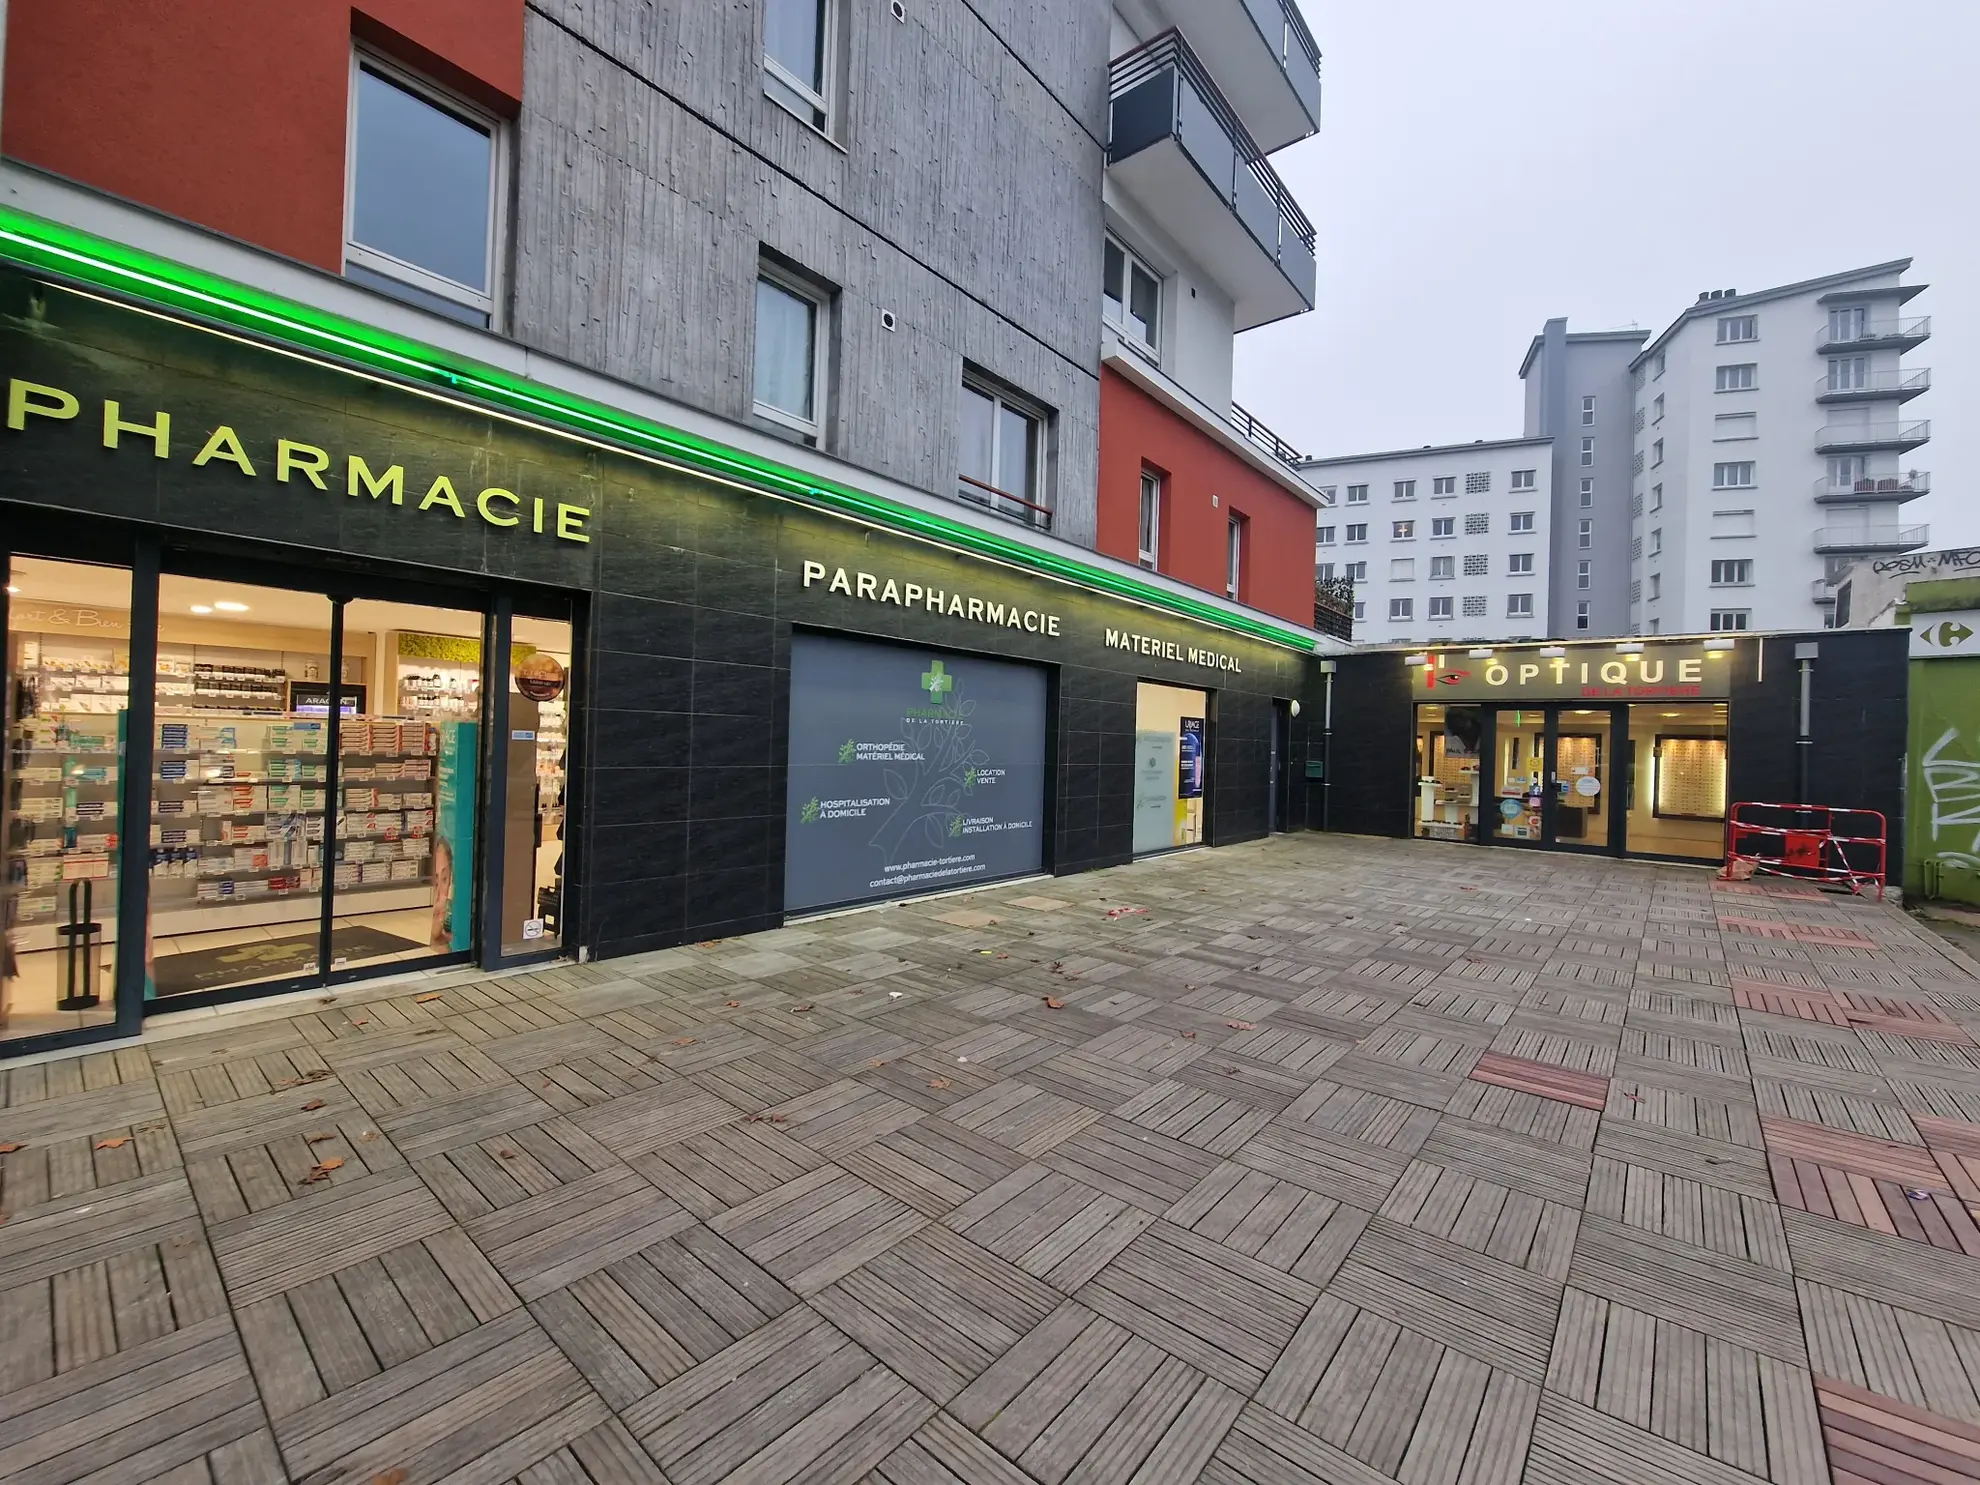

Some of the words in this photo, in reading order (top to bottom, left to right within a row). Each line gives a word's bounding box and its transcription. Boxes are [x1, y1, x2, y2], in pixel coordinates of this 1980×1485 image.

[7, 378, 590, 543] PHARMACIE
[803, 560, 1061, 637] PARAPHARMACIE
[48, 609, 70, 625] &
[1105, 628, 1184, 662] MATERIEL
[1188, 647, 1242, 673] MEDICAL
[1485, 659, 1703, 686] OPTIQUE
[305, 697, 348, 705] ARAN
[856, 742, 905, 751] ORTHOPÉDIE
[856, 751, 893, 761] MATÉRIEL
[895, 751, 925, 761] MÉDICAL
[820, 798, 890, 809] HOSPITALISATION
[820, 809, 827, 819] À
[827, 808, 867, 819] DOMICILE
[963, 817, 994, 826] LIVRAISON
[963, 823, 1002, 834] INSTALLATION
[1008, 821, 1033, 829] DOMICILE
[884, 853, 976, 873] www.pharmacie-tortiere.com
[869, 864, 986, 888] contact@pharmaciedelatortiere.com
